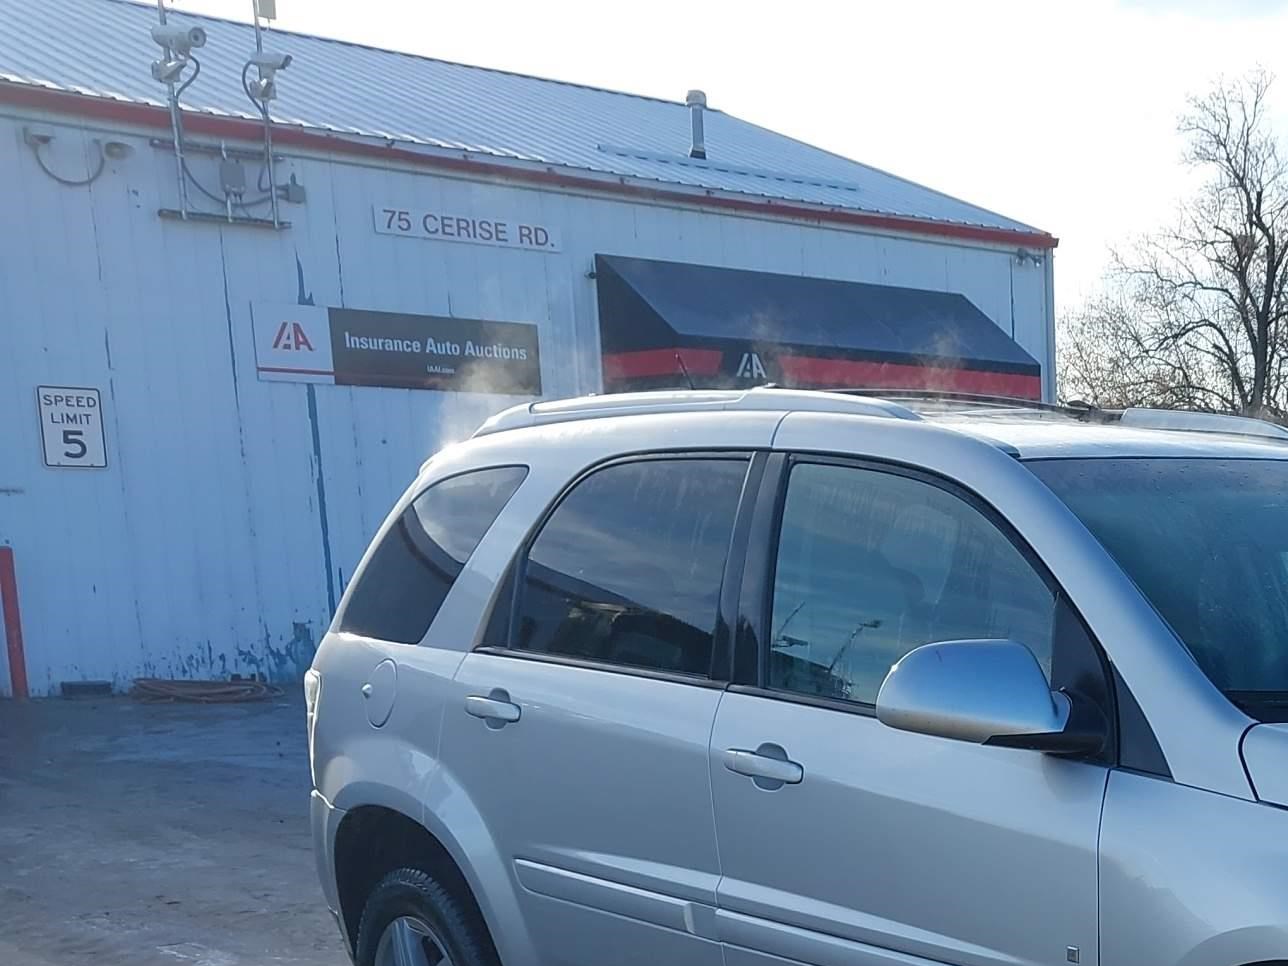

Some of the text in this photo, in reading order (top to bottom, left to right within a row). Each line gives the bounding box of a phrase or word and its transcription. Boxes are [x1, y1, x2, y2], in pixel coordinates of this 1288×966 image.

[382, 208, 556, 248] 75 CERISE RD.
[344, 331, 528, 360] Insurance Auto Auctions
[43, 394, 97, 408] SPEED
[50, 412, 92, 425] LIMIT
[62, 429, 87, 459] 5
